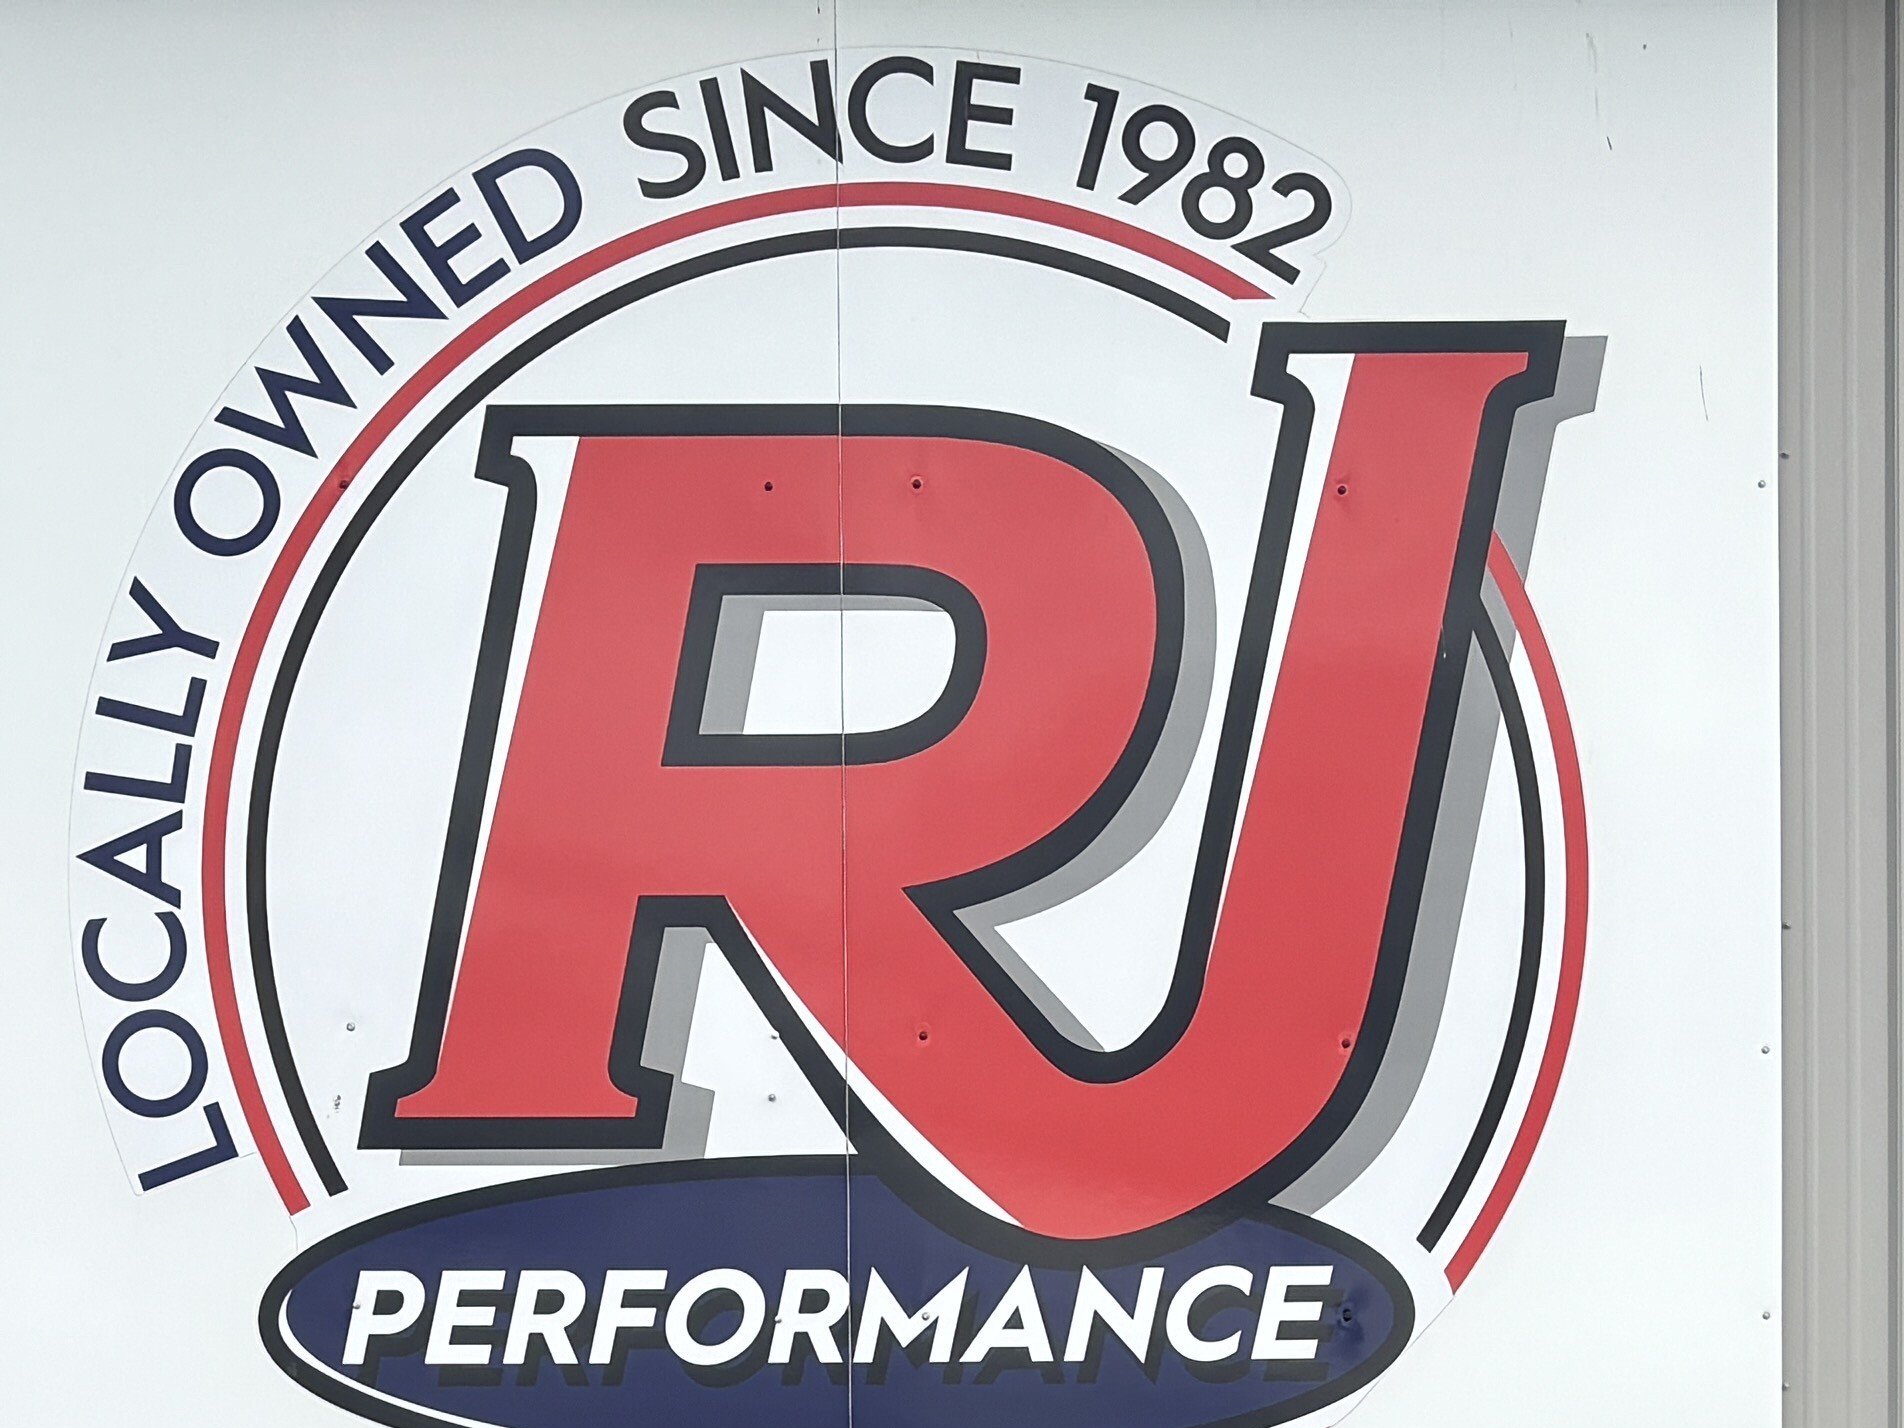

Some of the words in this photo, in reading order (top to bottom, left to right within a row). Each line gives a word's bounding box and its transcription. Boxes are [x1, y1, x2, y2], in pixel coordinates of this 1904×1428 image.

[76, 576, 239, 1192] LOCALLY
[174, 148, 584, 557] OWNED
[623, 55, 1022, 199] SINCE
[1076, 82, 1333, 285] 1982
[358, 319, 1567, 1263] RJ
[341, 1263, 1334, 1367] PERFORMANCE
